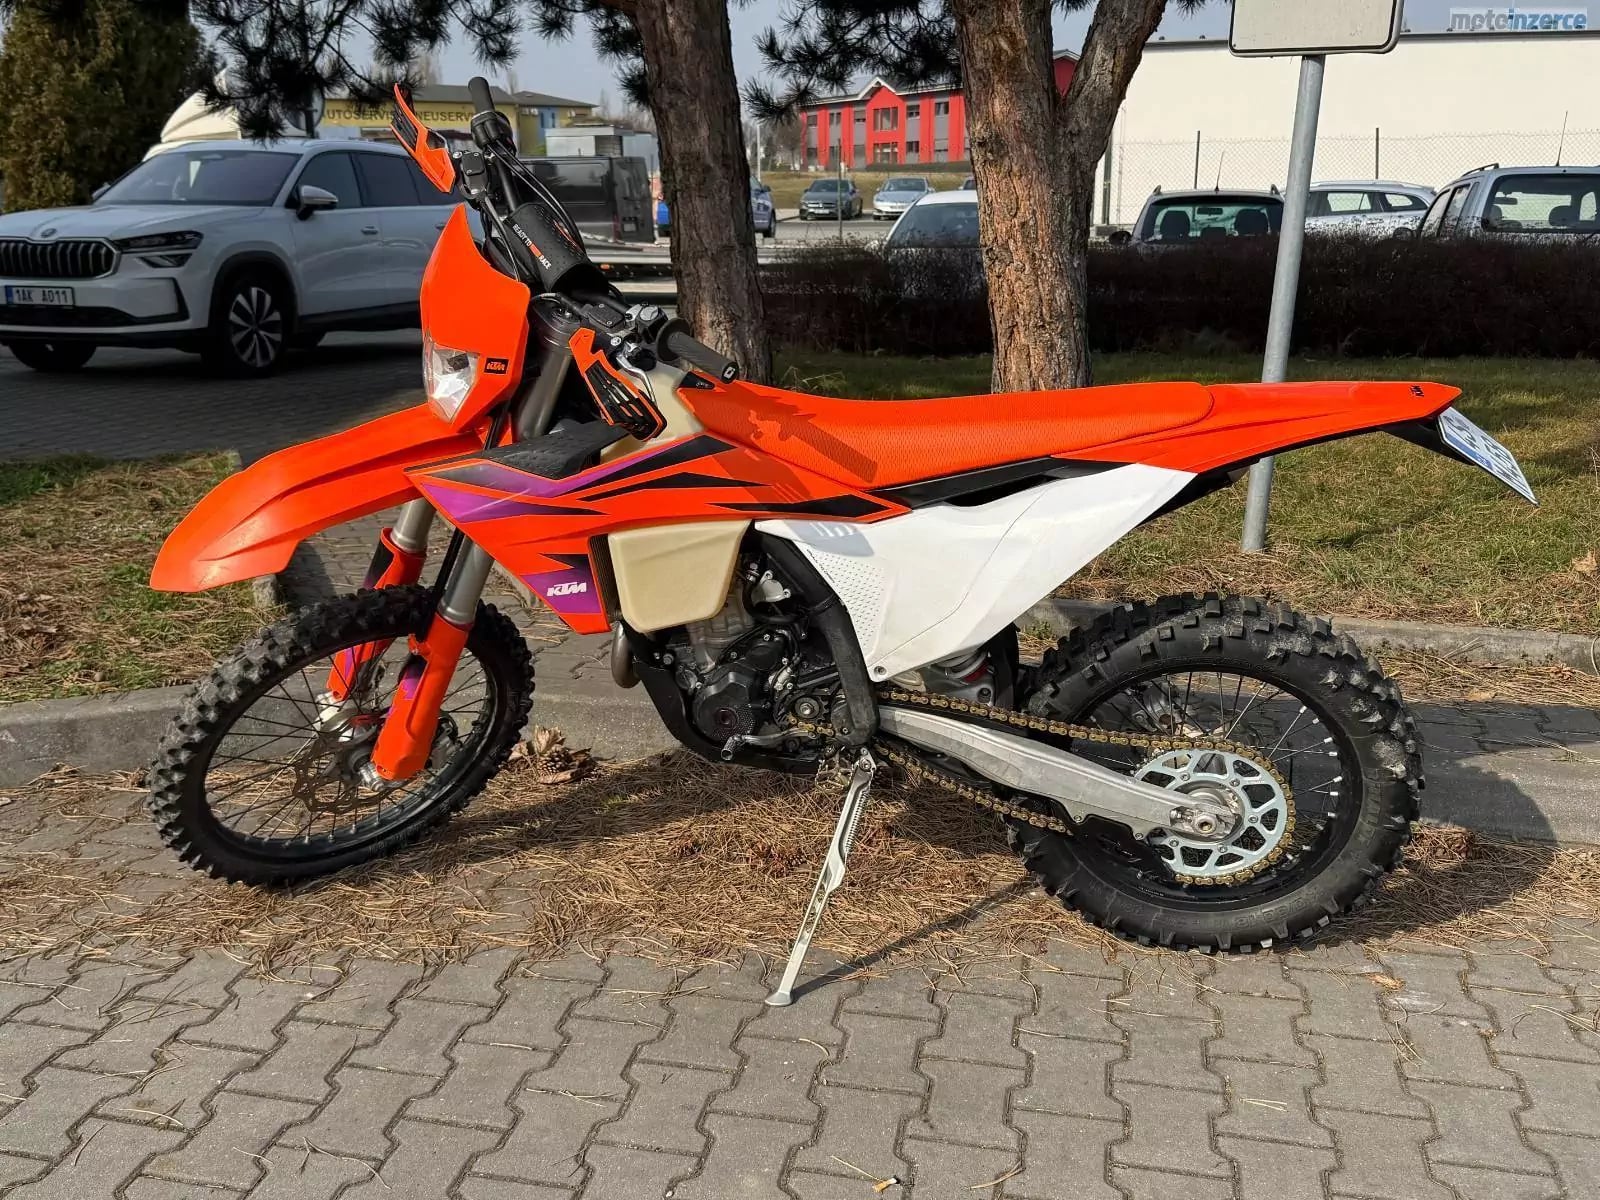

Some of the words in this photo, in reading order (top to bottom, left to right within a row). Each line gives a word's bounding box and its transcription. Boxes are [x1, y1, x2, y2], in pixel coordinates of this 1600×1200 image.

[415, 111, 475, 121] NEUSERV
[512, 223, 529, 241] READY
[538, 254, 552, 270] RACE
[486, 361, 506, 371] KTM
[546, 581, 587, 597] KTM
